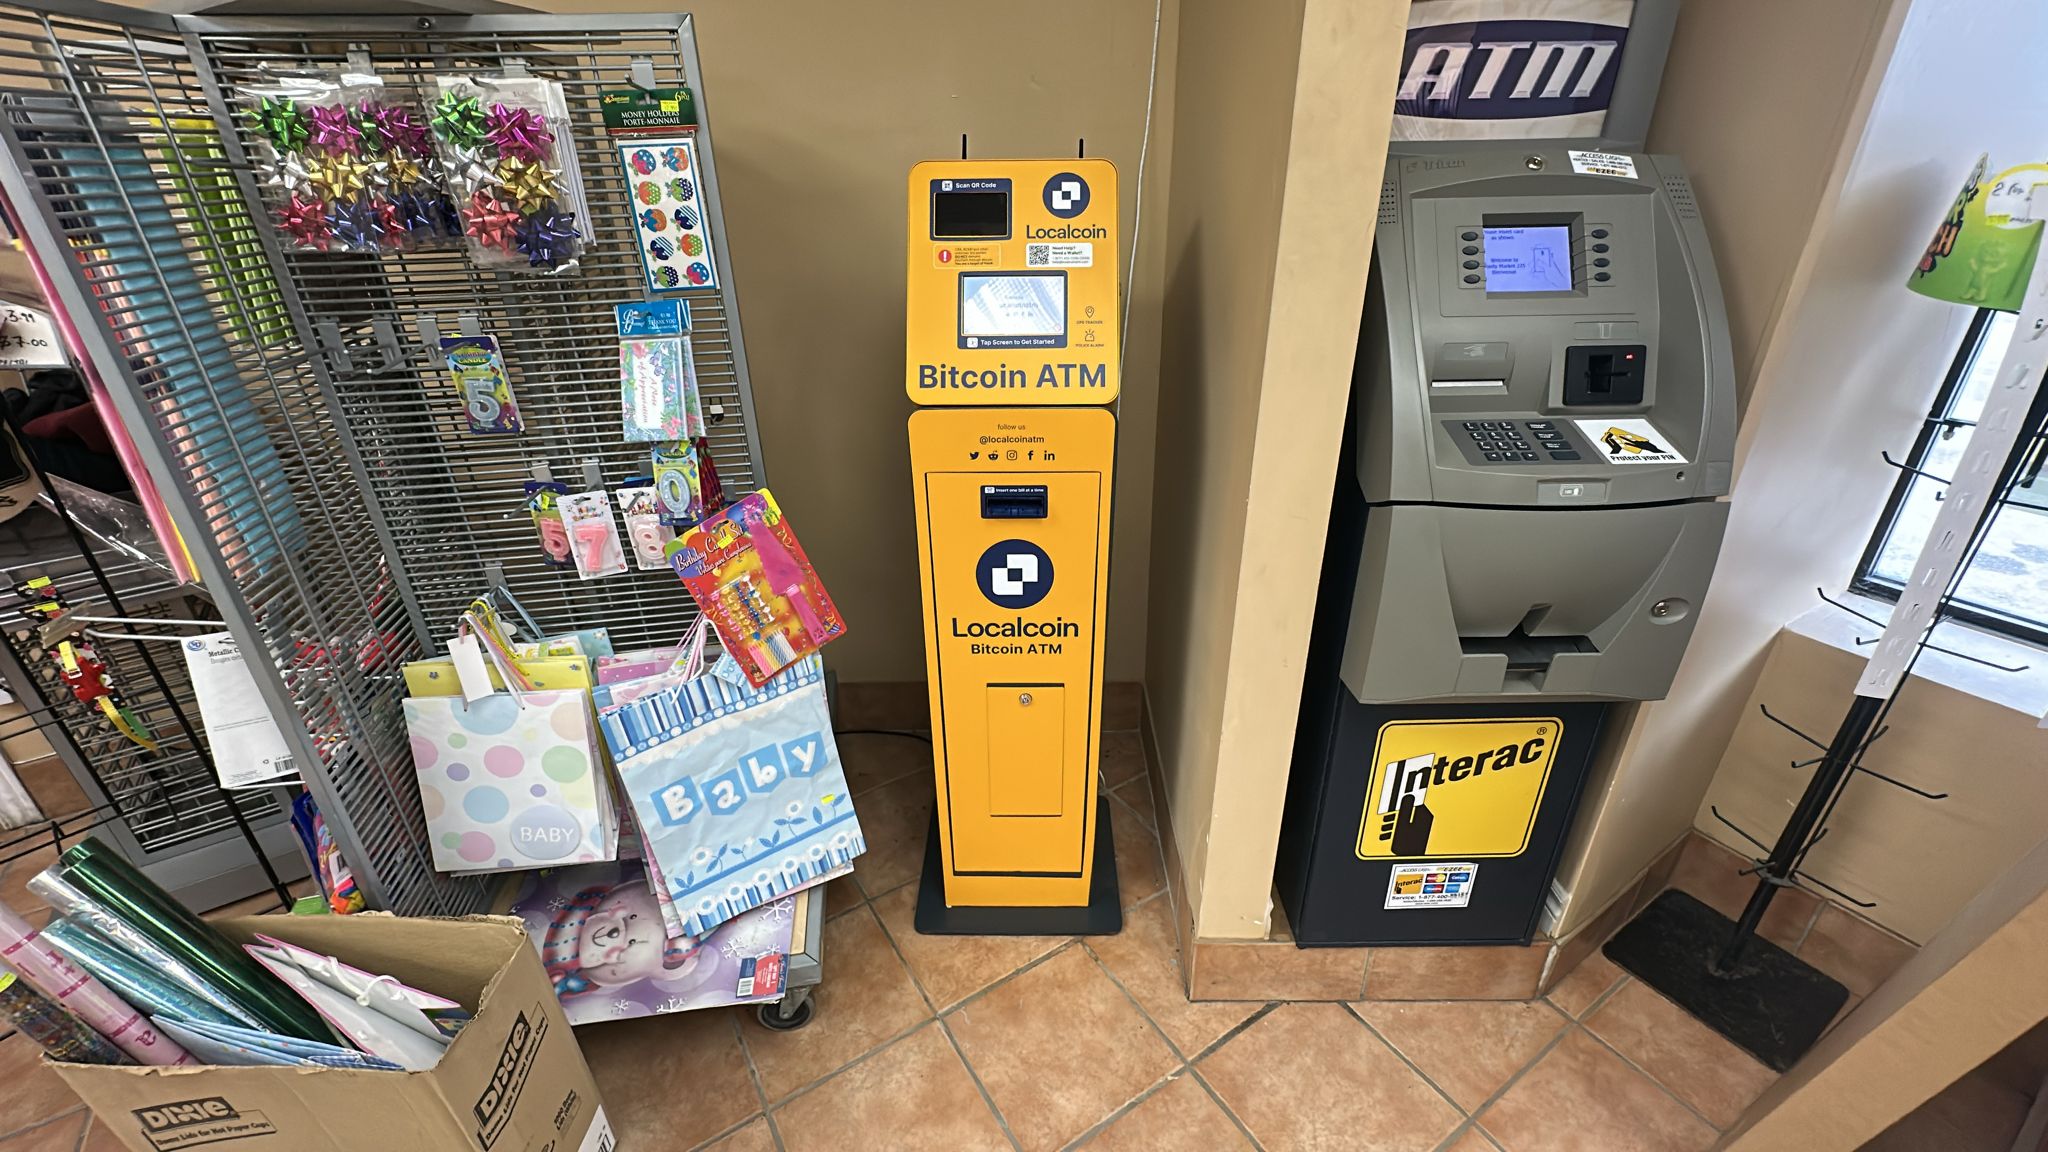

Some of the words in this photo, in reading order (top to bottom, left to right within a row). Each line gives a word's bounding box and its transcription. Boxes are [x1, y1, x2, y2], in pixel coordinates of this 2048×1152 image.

[1397, 41, 1618, 99] ATM
[621, 111, 646, 119] MONEY
[1026, 224, 1107, 239] Localcoin
[919, 363, 1026, 388] Bitcoin
[1036, 363, 1106, 388] ATM
[464, 376, 500, 428] 5
[979, 435, 1045, 445] @localcoinatm
[574, 523, 610, 572] 7
[634, 523, 668, 566] 8
[676, 547, 707, 573] Birthday
[952, 617, 1079, 638] Localcoin
[208, 648, 234, 658] Metallic
[971, 644, 1023, 655] Bitcoin
[1027, 644, 1062, 655] ATM
[660, 740, 819, 822] Baby
[1387, 737, 1546, 812] Interac
[520, 825, 575, 844] BABY
[1395, 878, 1423, 892] Interac
[525, 1036, 537, 1063] Paper
[535, 1016, 546, 1036] Cups
[181, 1131, 199, 1141] Lids
[210, 1127, 227, 1136] Hot
[227, 1124, 250, 1135] Paper
[250, 1121, 270, 1131] Cups
